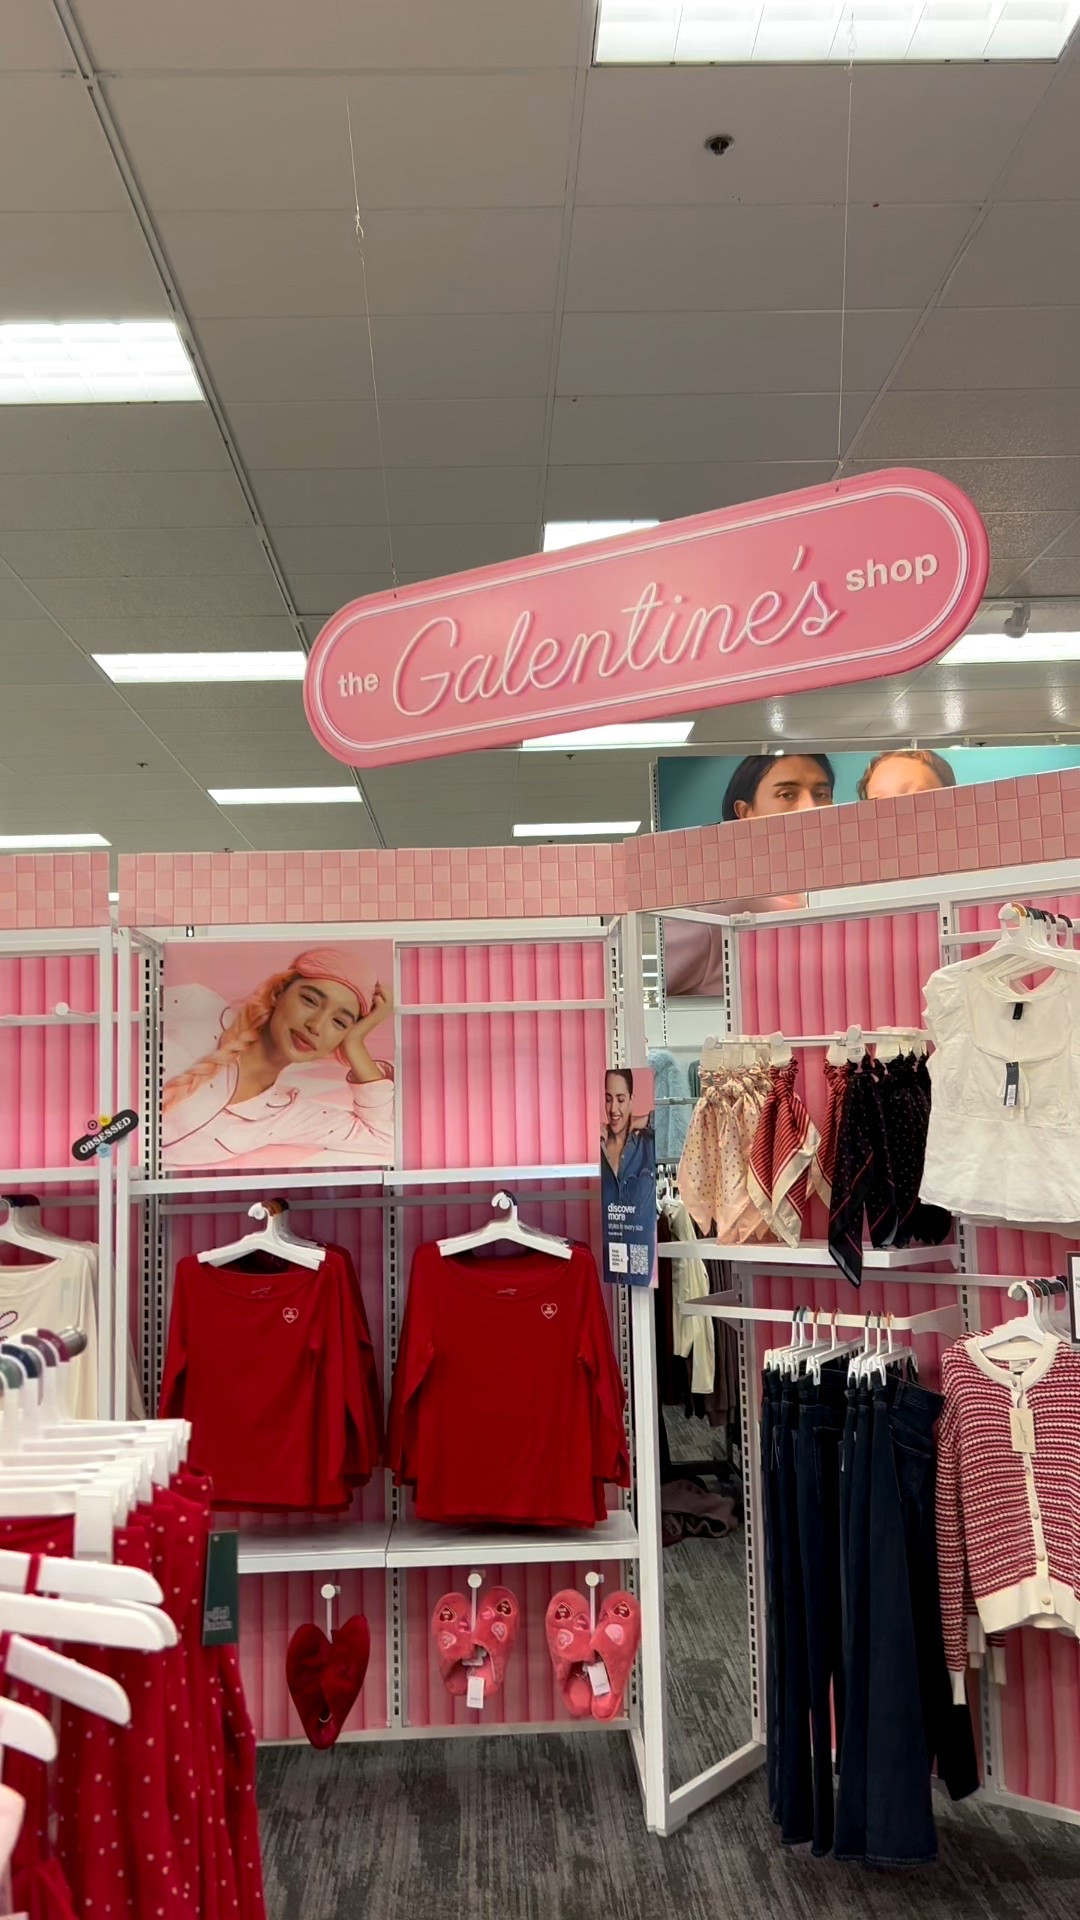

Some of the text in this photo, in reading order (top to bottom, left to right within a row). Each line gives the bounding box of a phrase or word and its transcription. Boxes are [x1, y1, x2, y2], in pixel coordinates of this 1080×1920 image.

[337, 545, 939, 718] the Galentine's shop
[79, 1116, 131, 1154] OBSESSED
[607, 1203, 636, 1213] discover
[608, 1213, 626, 1221] more
